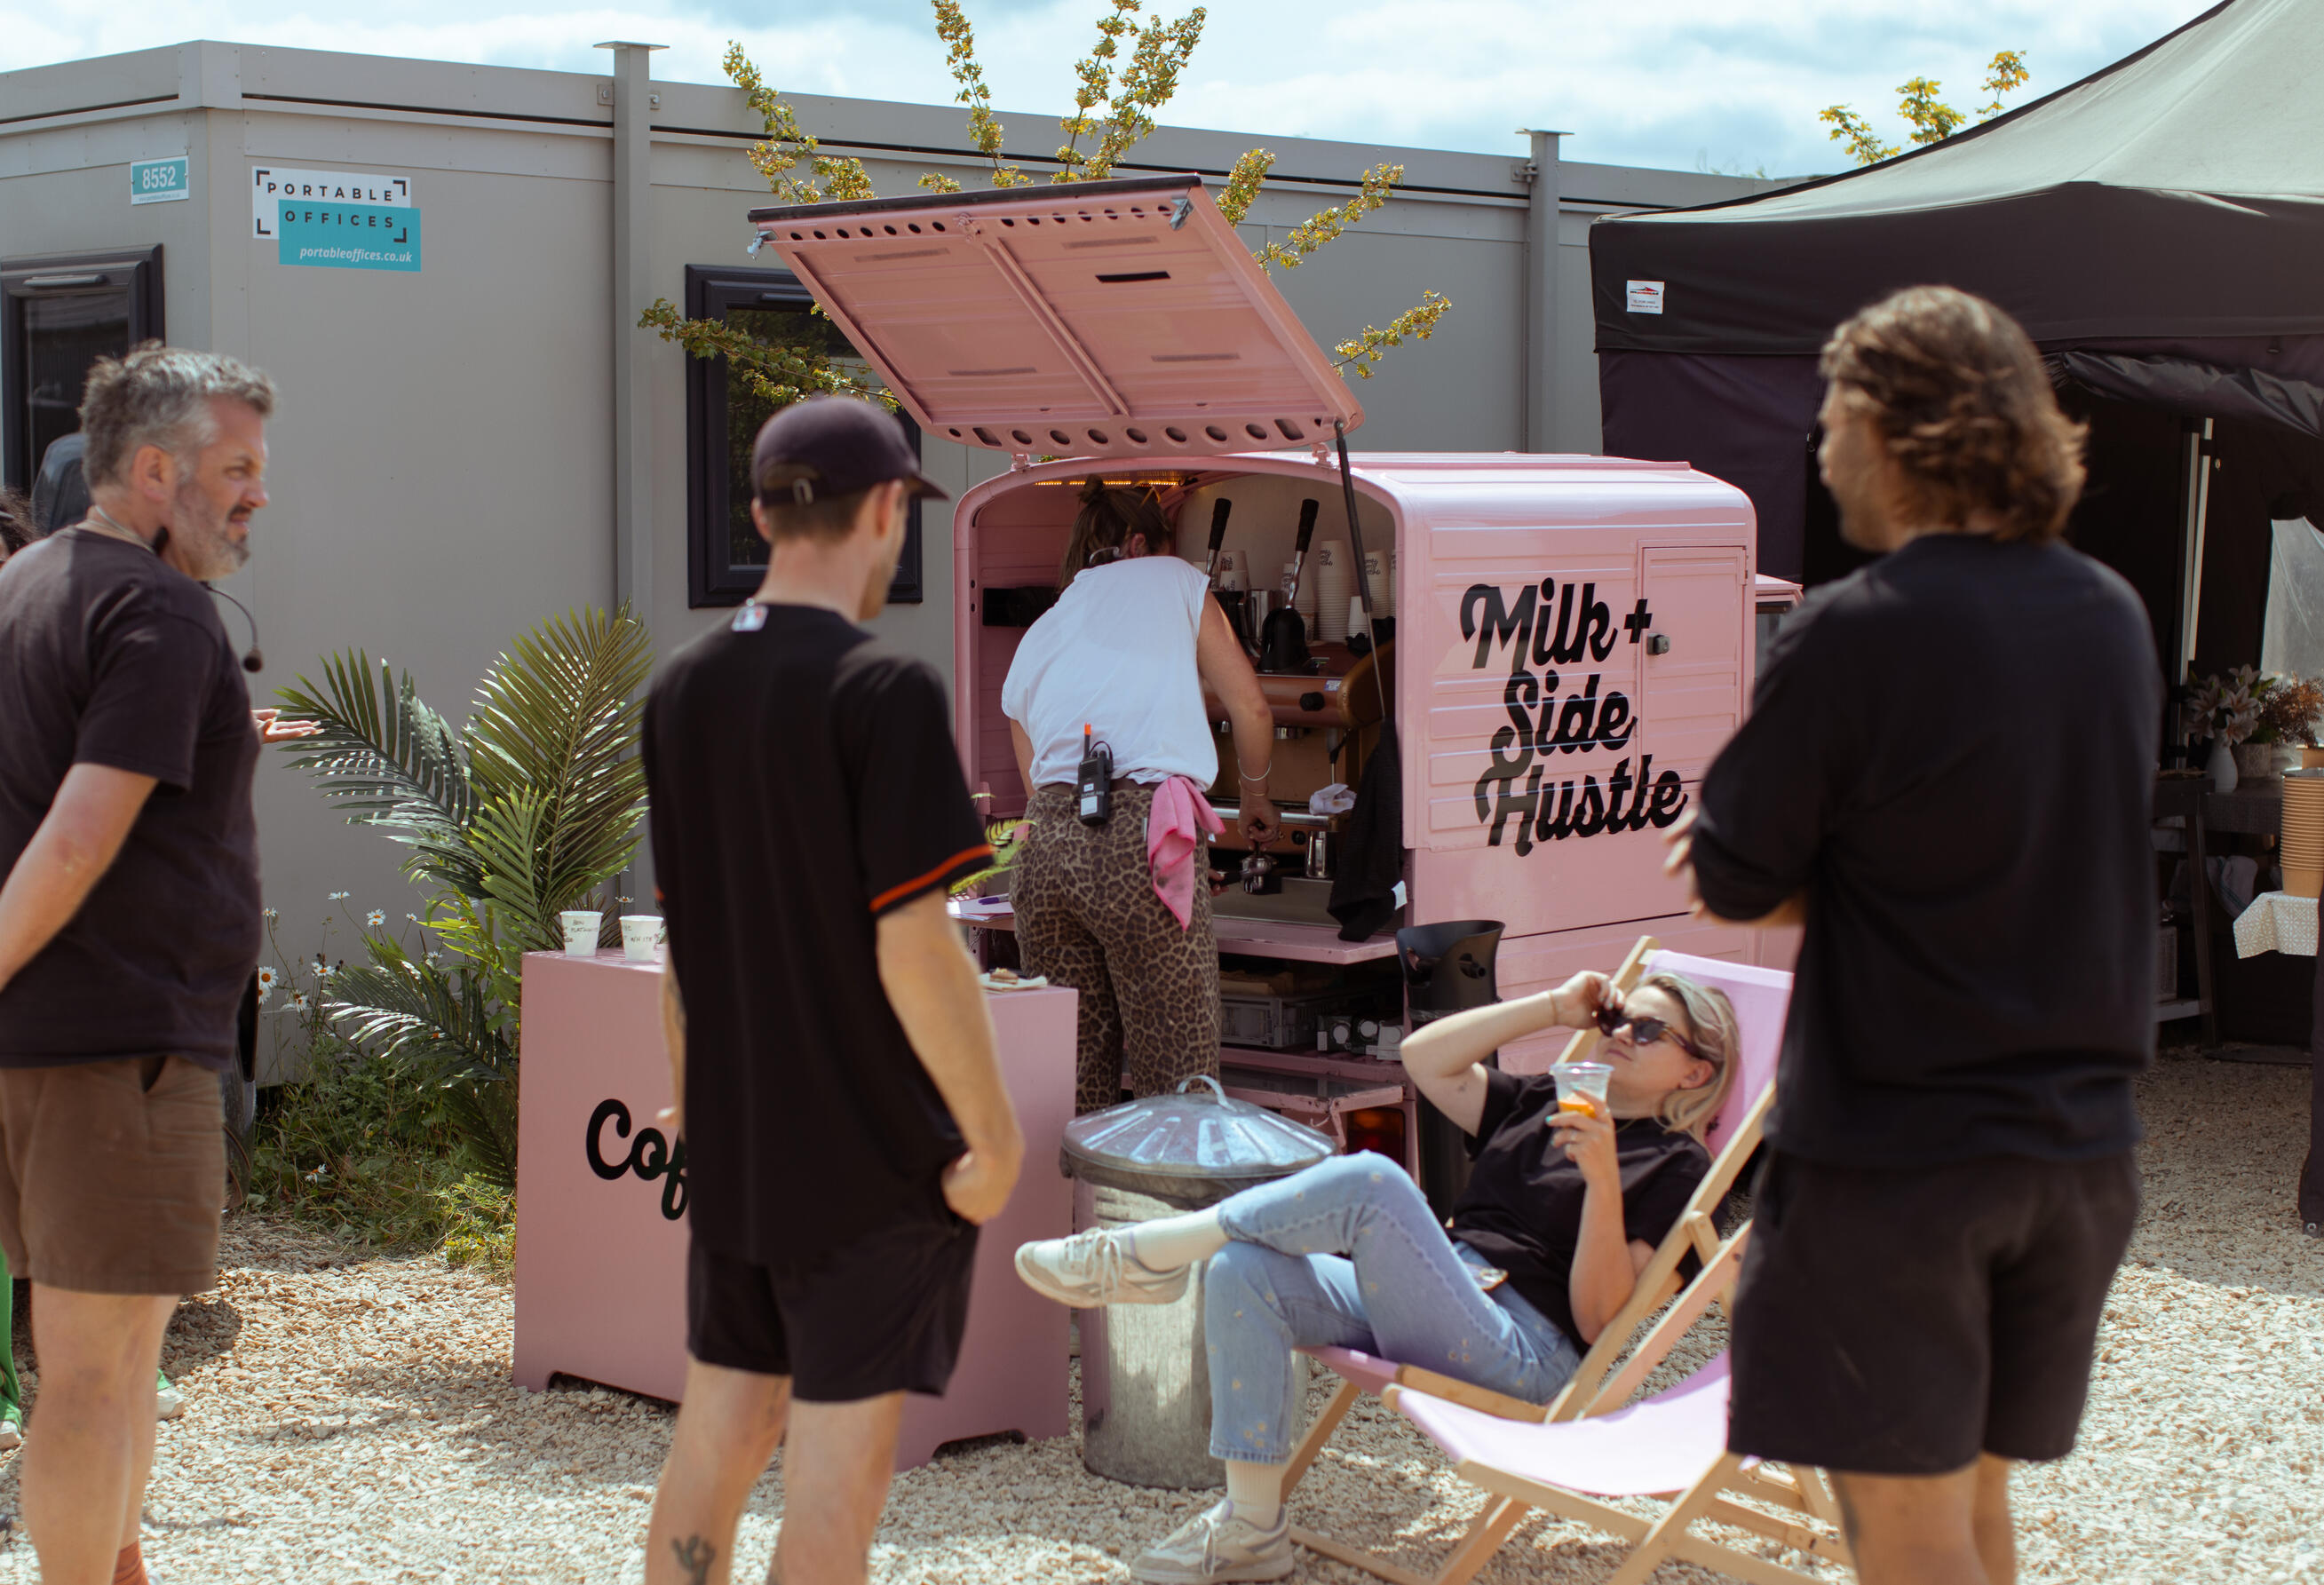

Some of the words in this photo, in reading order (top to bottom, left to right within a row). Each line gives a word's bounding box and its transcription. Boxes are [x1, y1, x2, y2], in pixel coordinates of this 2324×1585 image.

[142, 165, 176, 190] 8552
[267, 182, 393, 202] PORTABLE
[284, 210, 393, 228] OFFICES
[299, 246, 413, 263] portableoffices.co.uk
[1489, 669, 1638, 776] Side
[1474, 754, 1689, 857] Hustle
